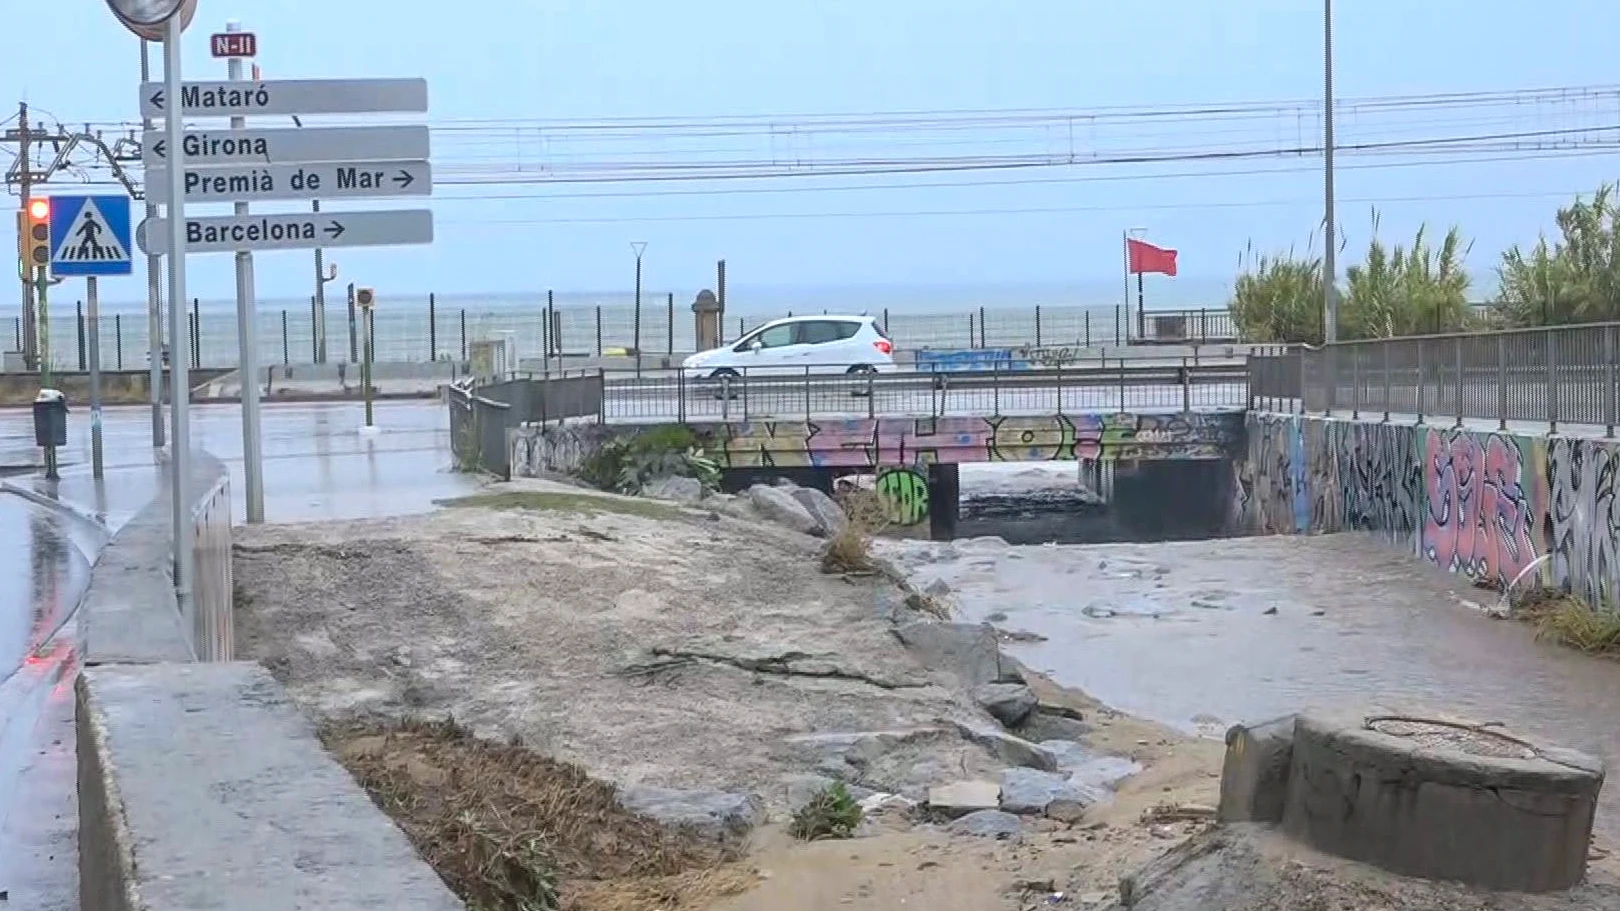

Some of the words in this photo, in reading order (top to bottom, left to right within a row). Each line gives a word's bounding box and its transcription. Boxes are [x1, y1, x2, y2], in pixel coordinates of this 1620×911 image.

[181, 84, 269, 108] Mataró
[183, 134, 268, 156] Girona
[184, 170, 274, 194] Premià
[290, 169, 320, 190] de
[337, 168, 384, 189] Mar
[186, 219, 316, 243] Barcelona
